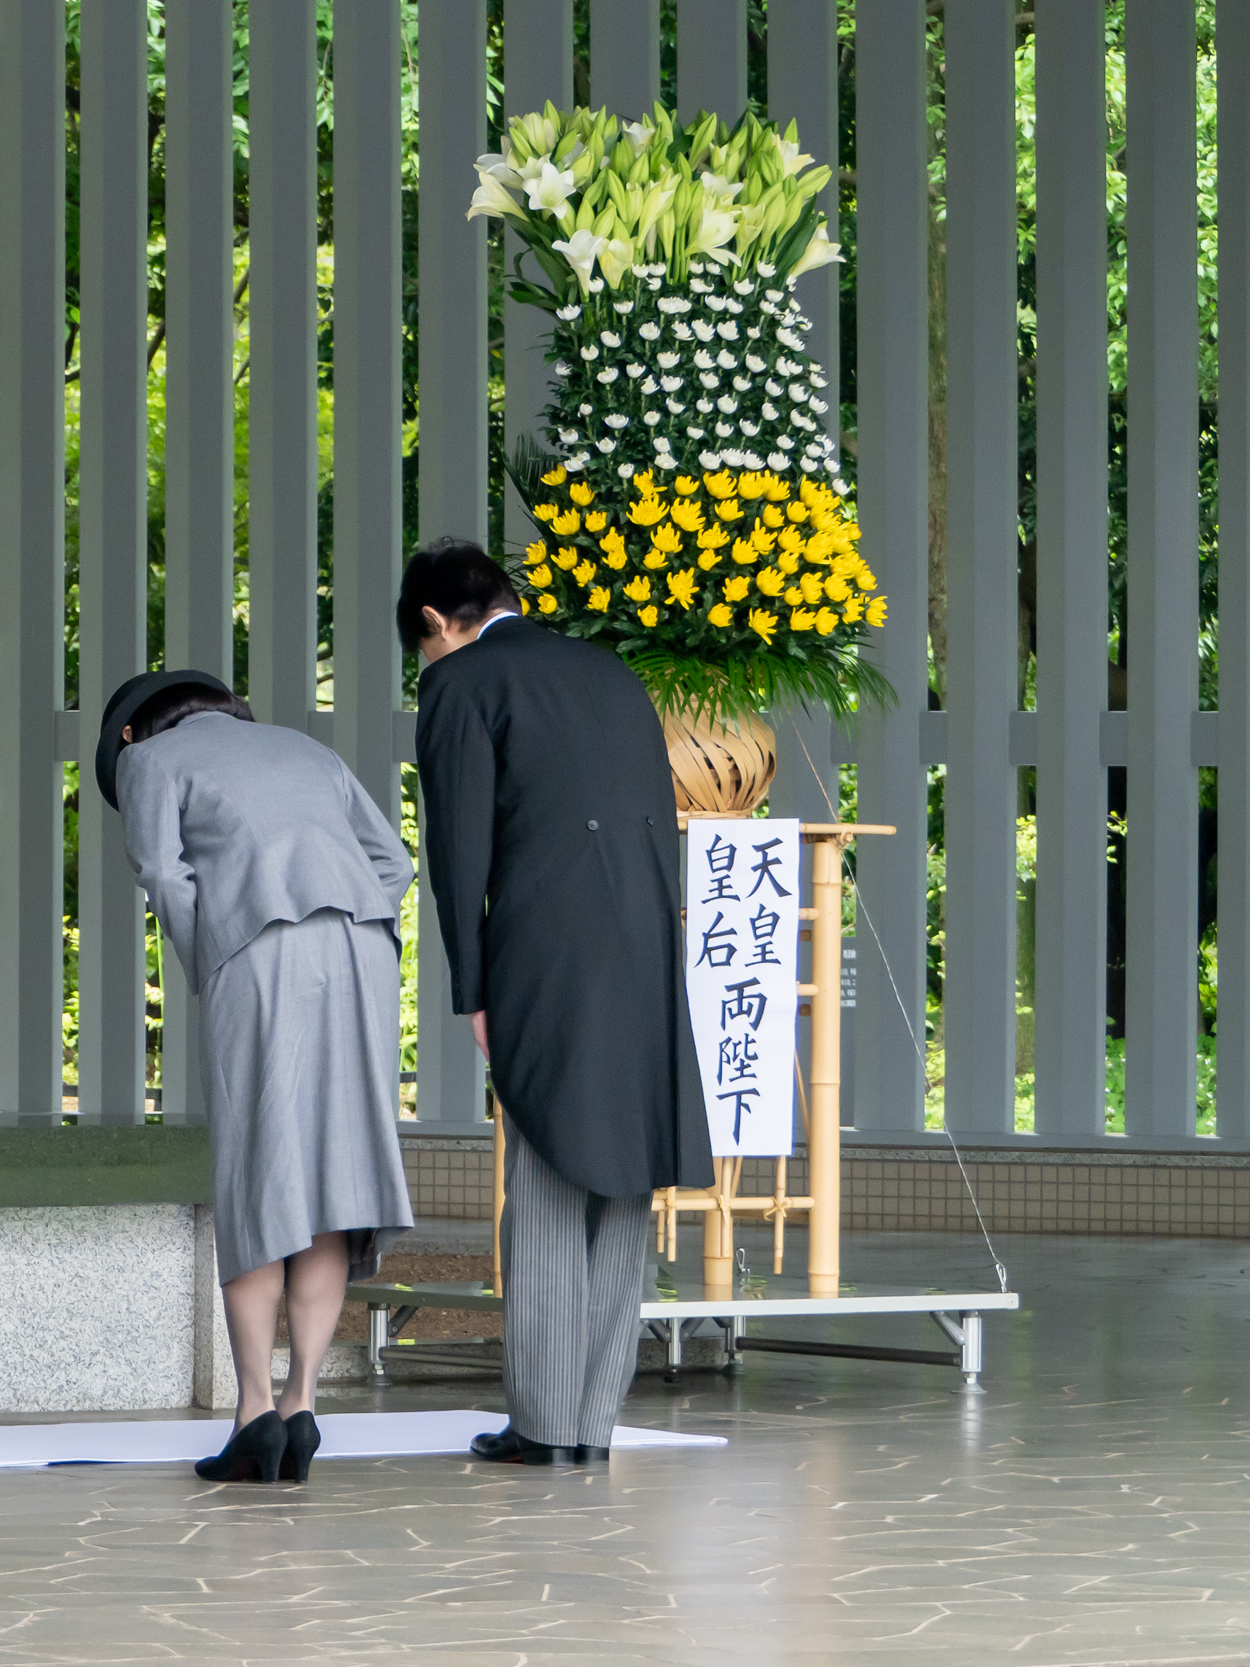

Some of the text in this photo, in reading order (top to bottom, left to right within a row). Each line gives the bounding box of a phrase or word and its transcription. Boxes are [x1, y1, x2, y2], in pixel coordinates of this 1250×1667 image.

[694, 833, 741, 969] 皇后
[744, 837, 793, 967] 天皇
[716, 976, 768, 1146] 両陛下
